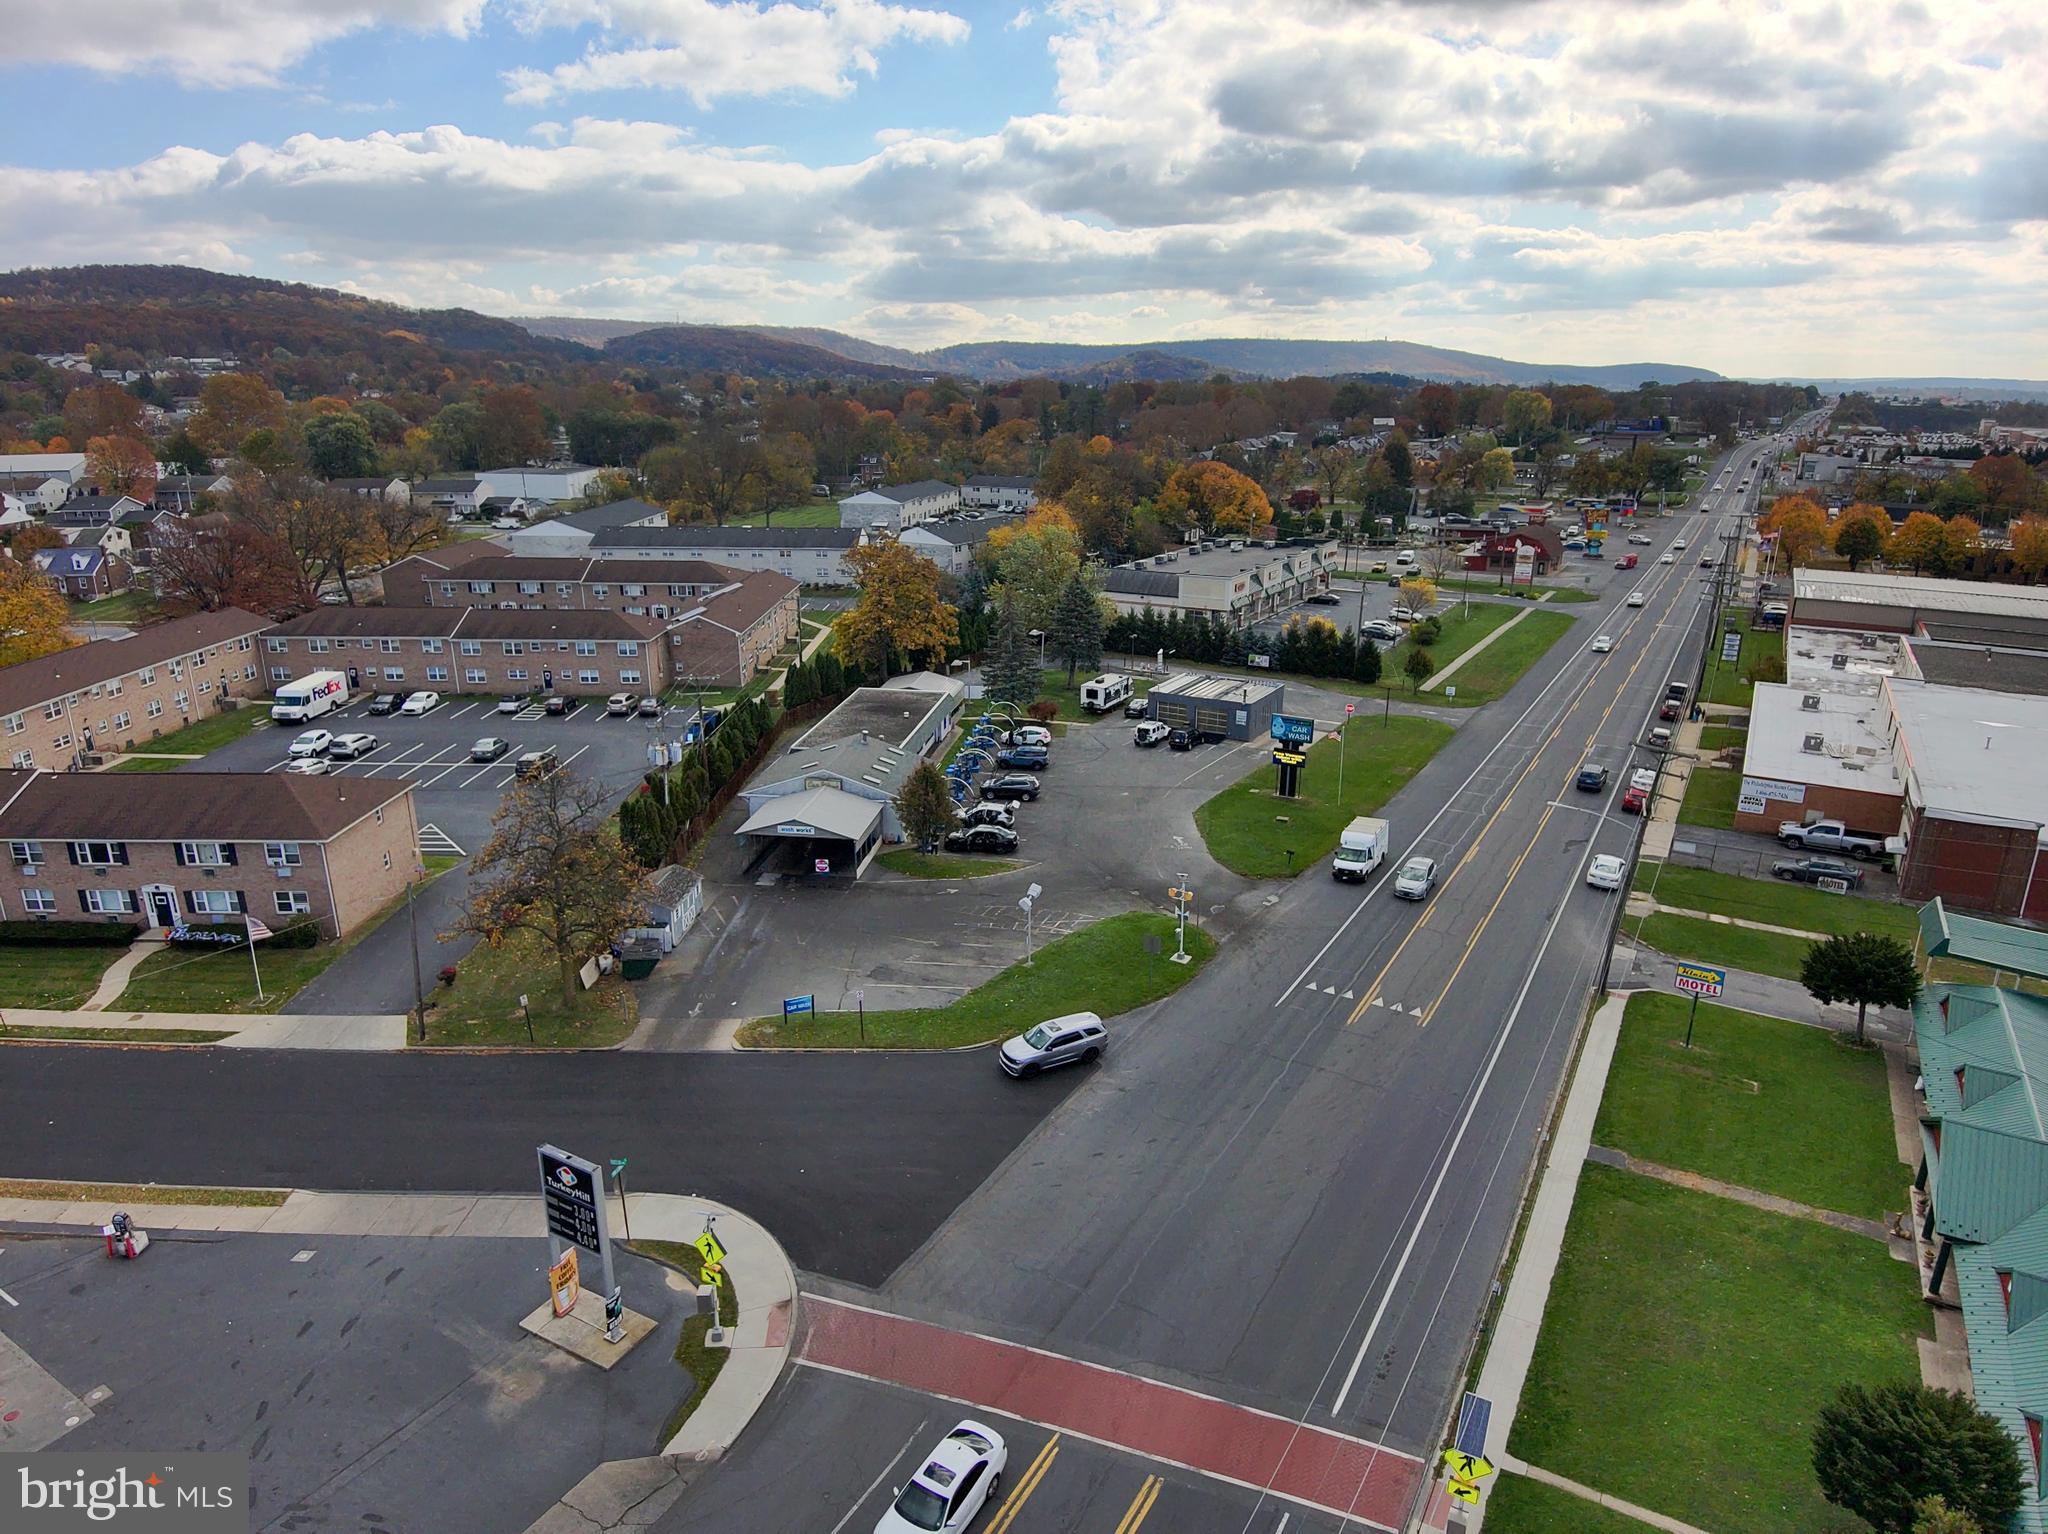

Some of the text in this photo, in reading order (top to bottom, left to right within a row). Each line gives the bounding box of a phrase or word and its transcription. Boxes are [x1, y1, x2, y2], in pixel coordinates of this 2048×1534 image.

[312, 680, 341, 701] FedEx
[1288, 732, 1310, 741] WASH
[1291, 726, 1307, 734] CAR
[1678, 978, 1719, 995] MOTEL
